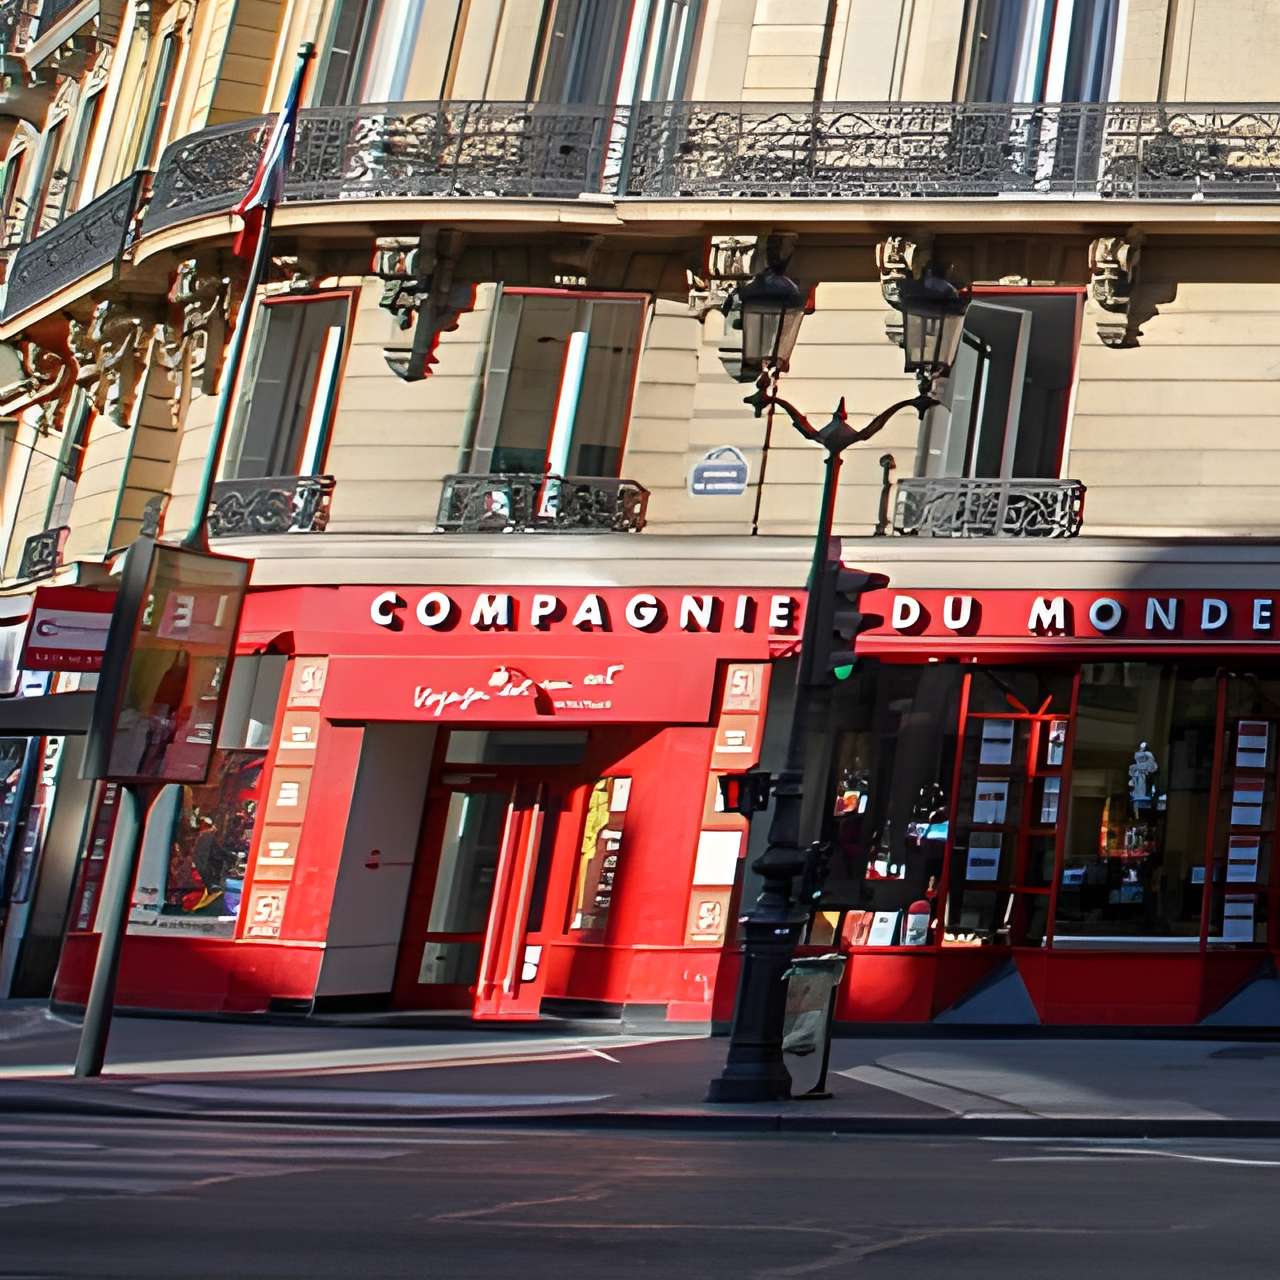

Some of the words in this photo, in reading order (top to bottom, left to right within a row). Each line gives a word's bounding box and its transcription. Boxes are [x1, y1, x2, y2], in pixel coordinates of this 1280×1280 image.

[369, 590, 794, 630] COMPAGNIE
[891, 594, 973, 630] DU
[1026, 595, 1273, 632] MONDE
